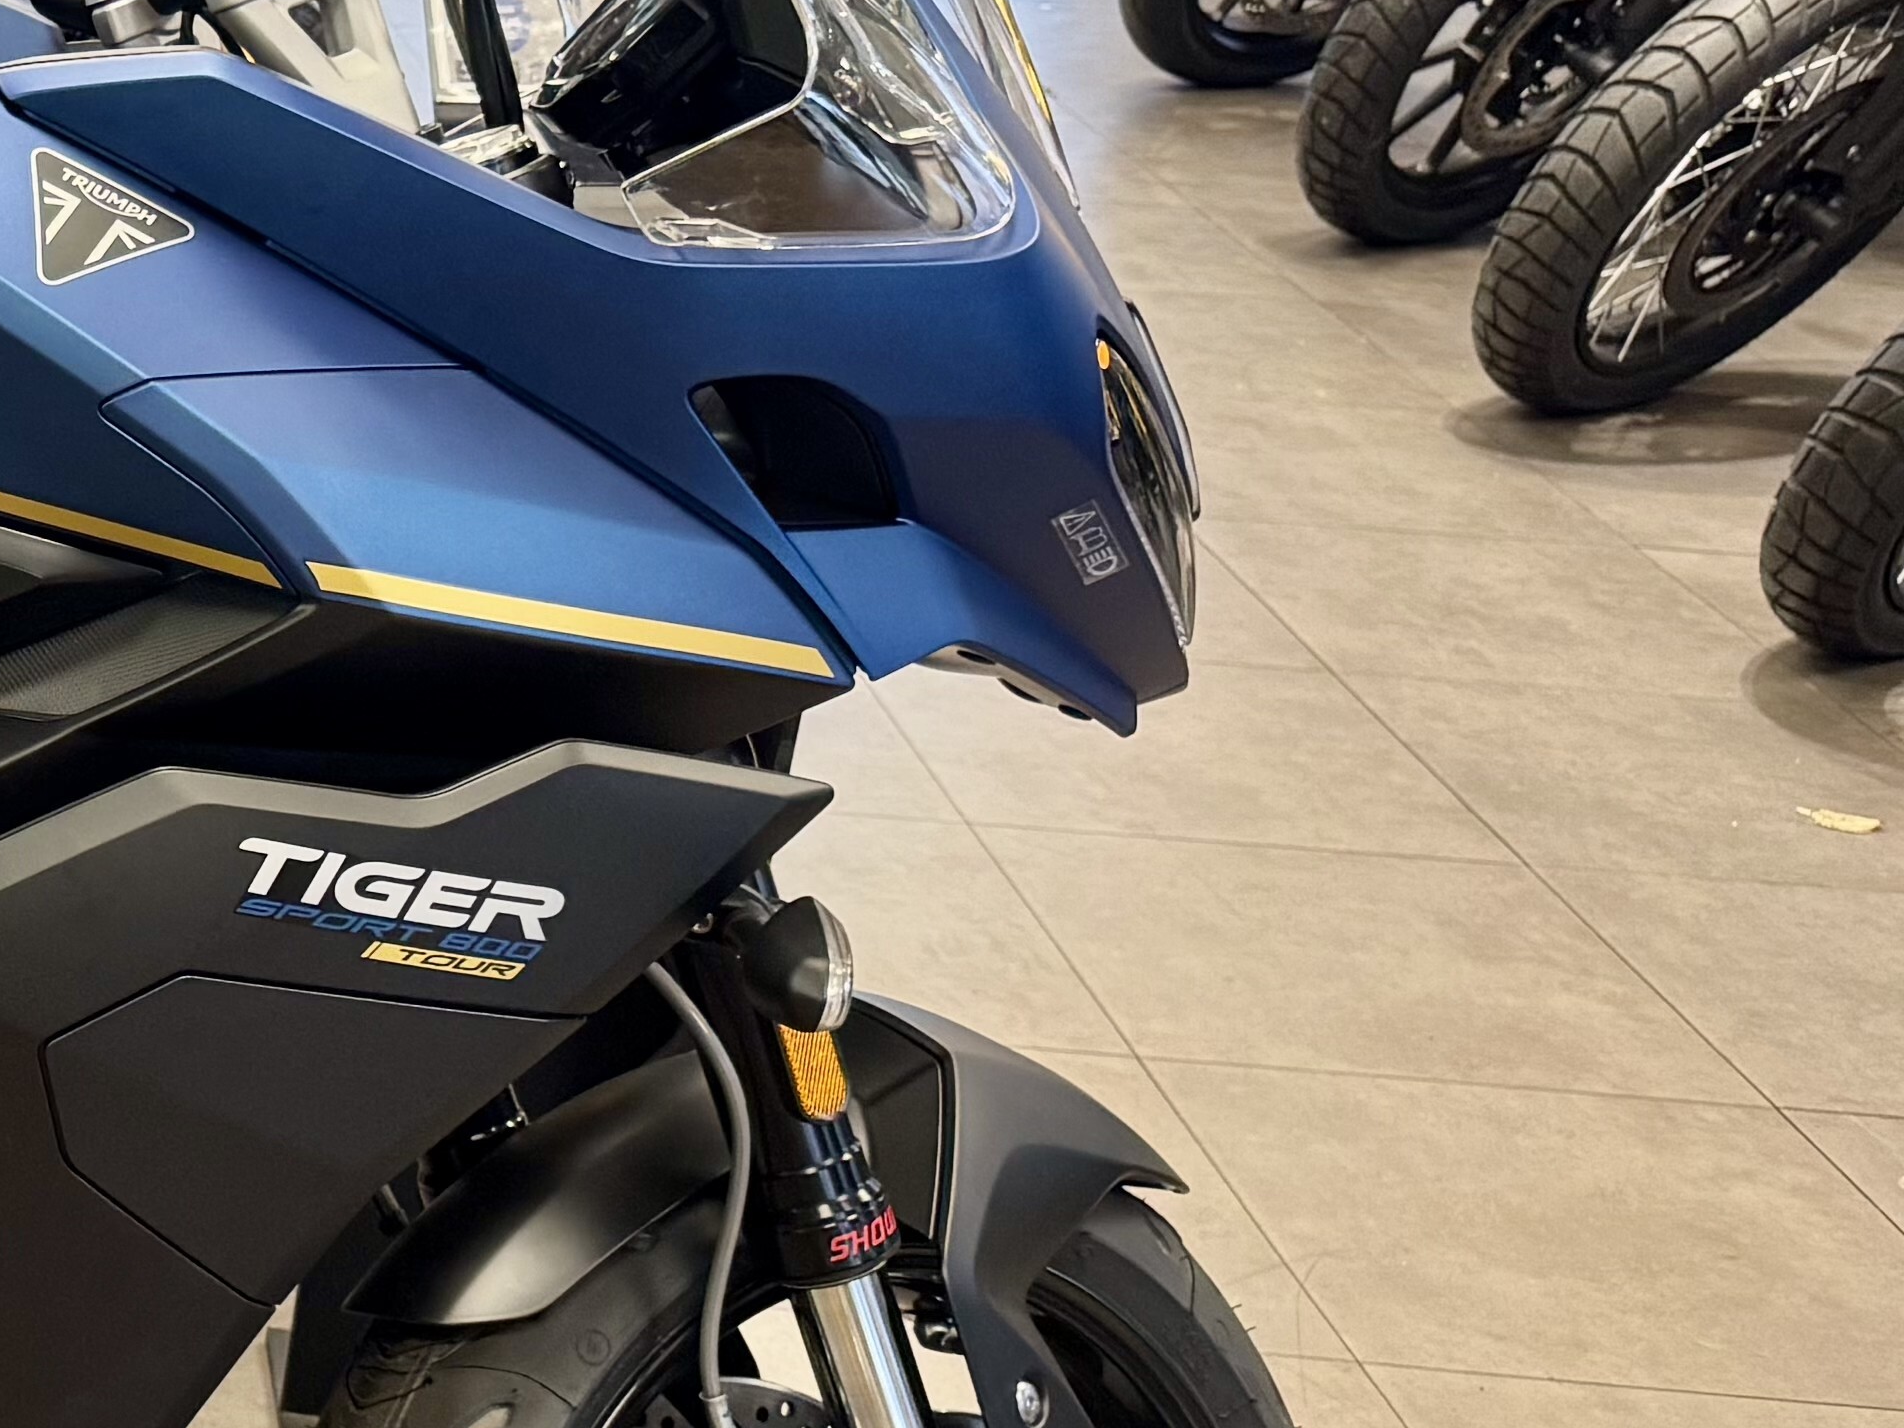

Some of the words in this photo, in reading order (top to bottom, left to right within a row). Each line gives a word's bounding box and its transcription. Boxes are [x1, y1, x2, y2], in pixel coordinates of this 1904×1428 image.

[61, 167, 158, 226] TRIUMPH
[239, 837, 566, 942] TIGER
[235, 898, 435, 941] SPORT
[438, 932, 545, 962] 800
[398, 948, 518, 977] TOUR
[829, 1204, 898, 1264] SHOW
